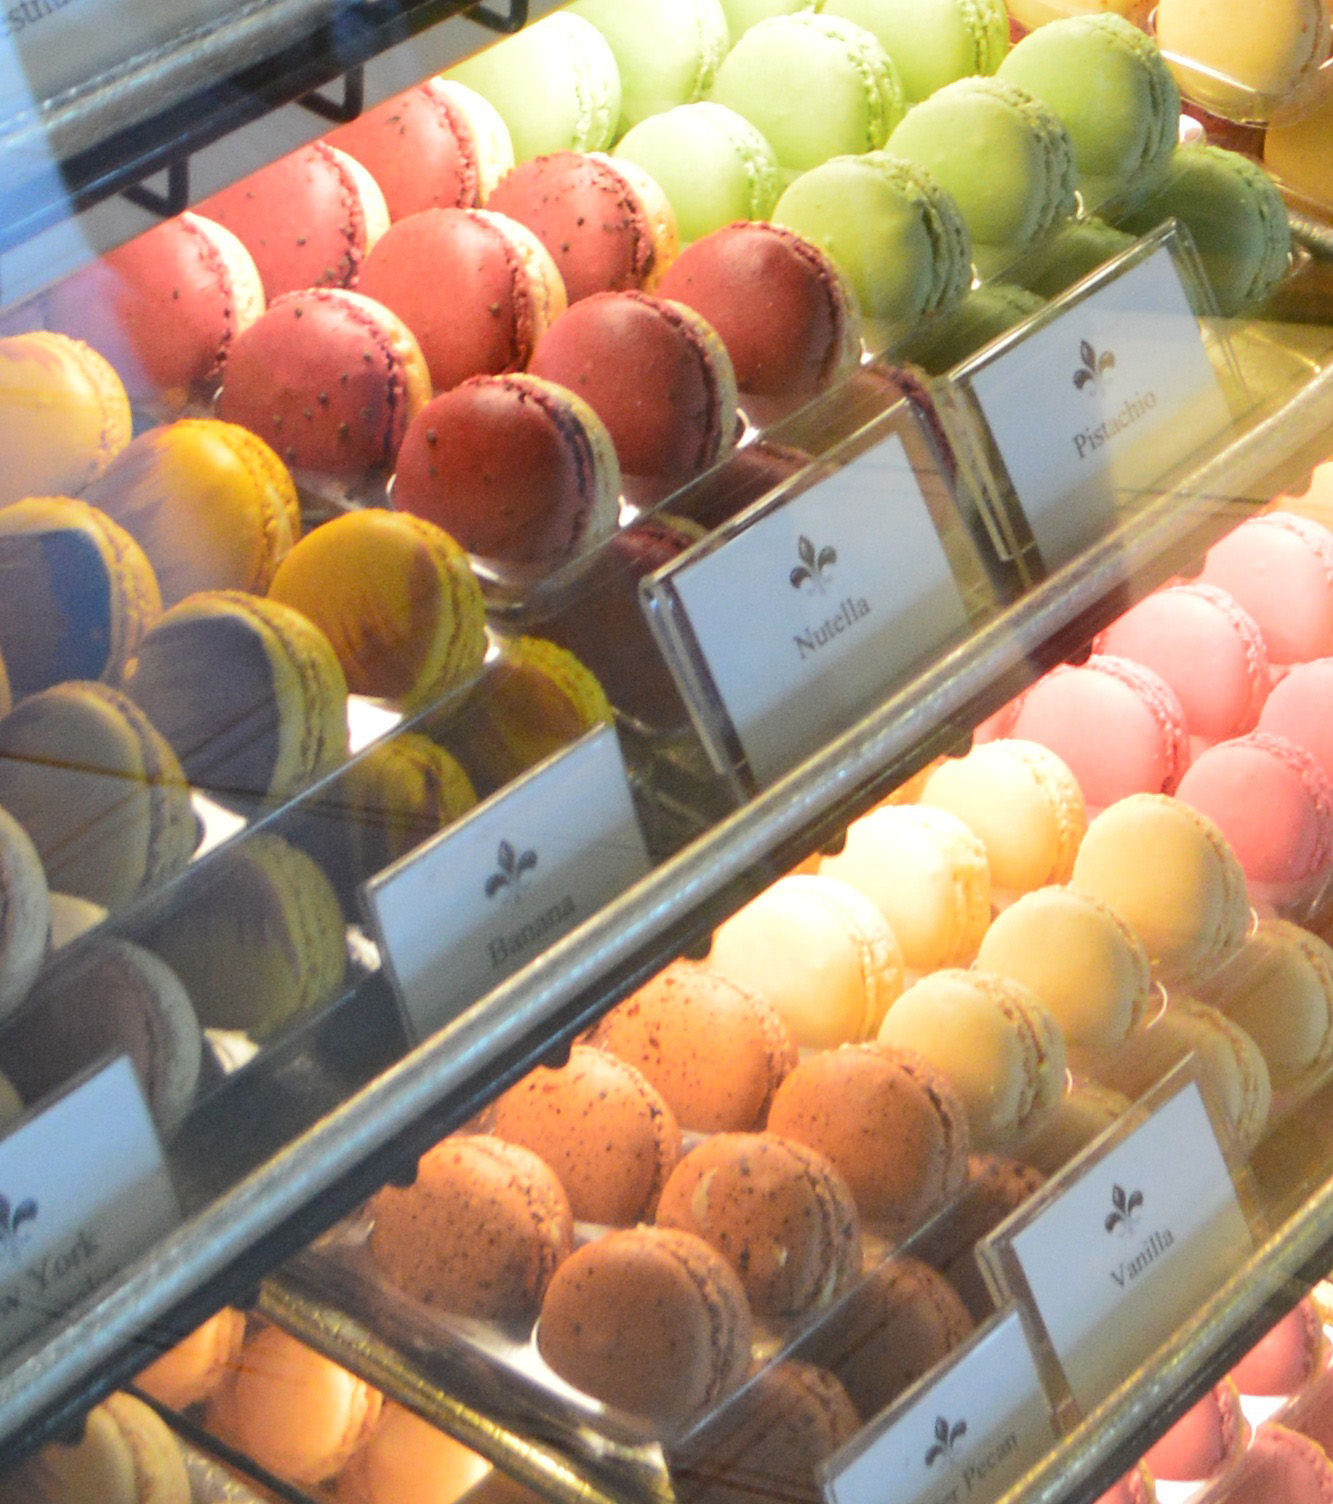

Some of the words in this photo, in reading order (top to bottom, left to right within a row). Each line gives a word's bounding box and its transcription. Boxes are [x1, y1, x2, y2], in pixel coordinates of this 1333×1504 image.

[1071, 389, 1159, 461] Pistachio
[791, 592, 872, 661] Nutella
[485, 894, 577, 968] Banana
[1108, 1226, 1176, 1289] Vanilla
